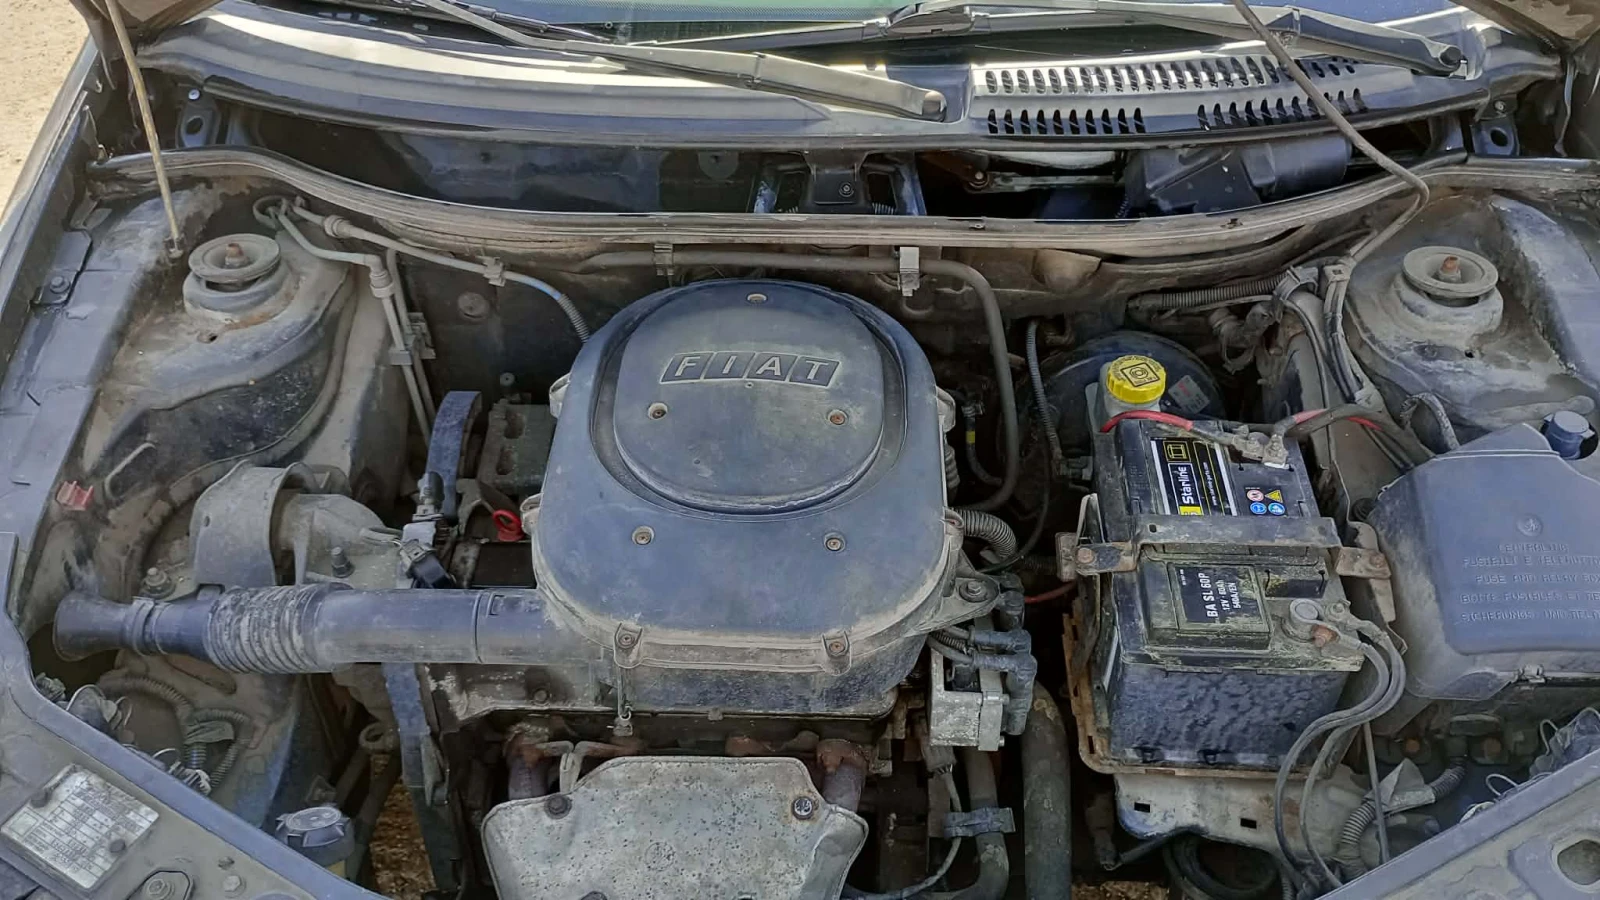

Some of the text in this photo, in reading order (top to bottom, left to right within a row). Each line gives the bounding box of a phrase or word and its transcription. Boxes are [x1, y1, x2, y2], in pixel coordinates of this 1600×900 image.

[674, 355, 830, 380] FIAT
[1179, 466, 1195, 505] Starline
[1475, 574, 1507, 584] FUSE
[1198, 573, 1218, 617] BA SL 60P
[1221, 598, 1231, 611] 12V
